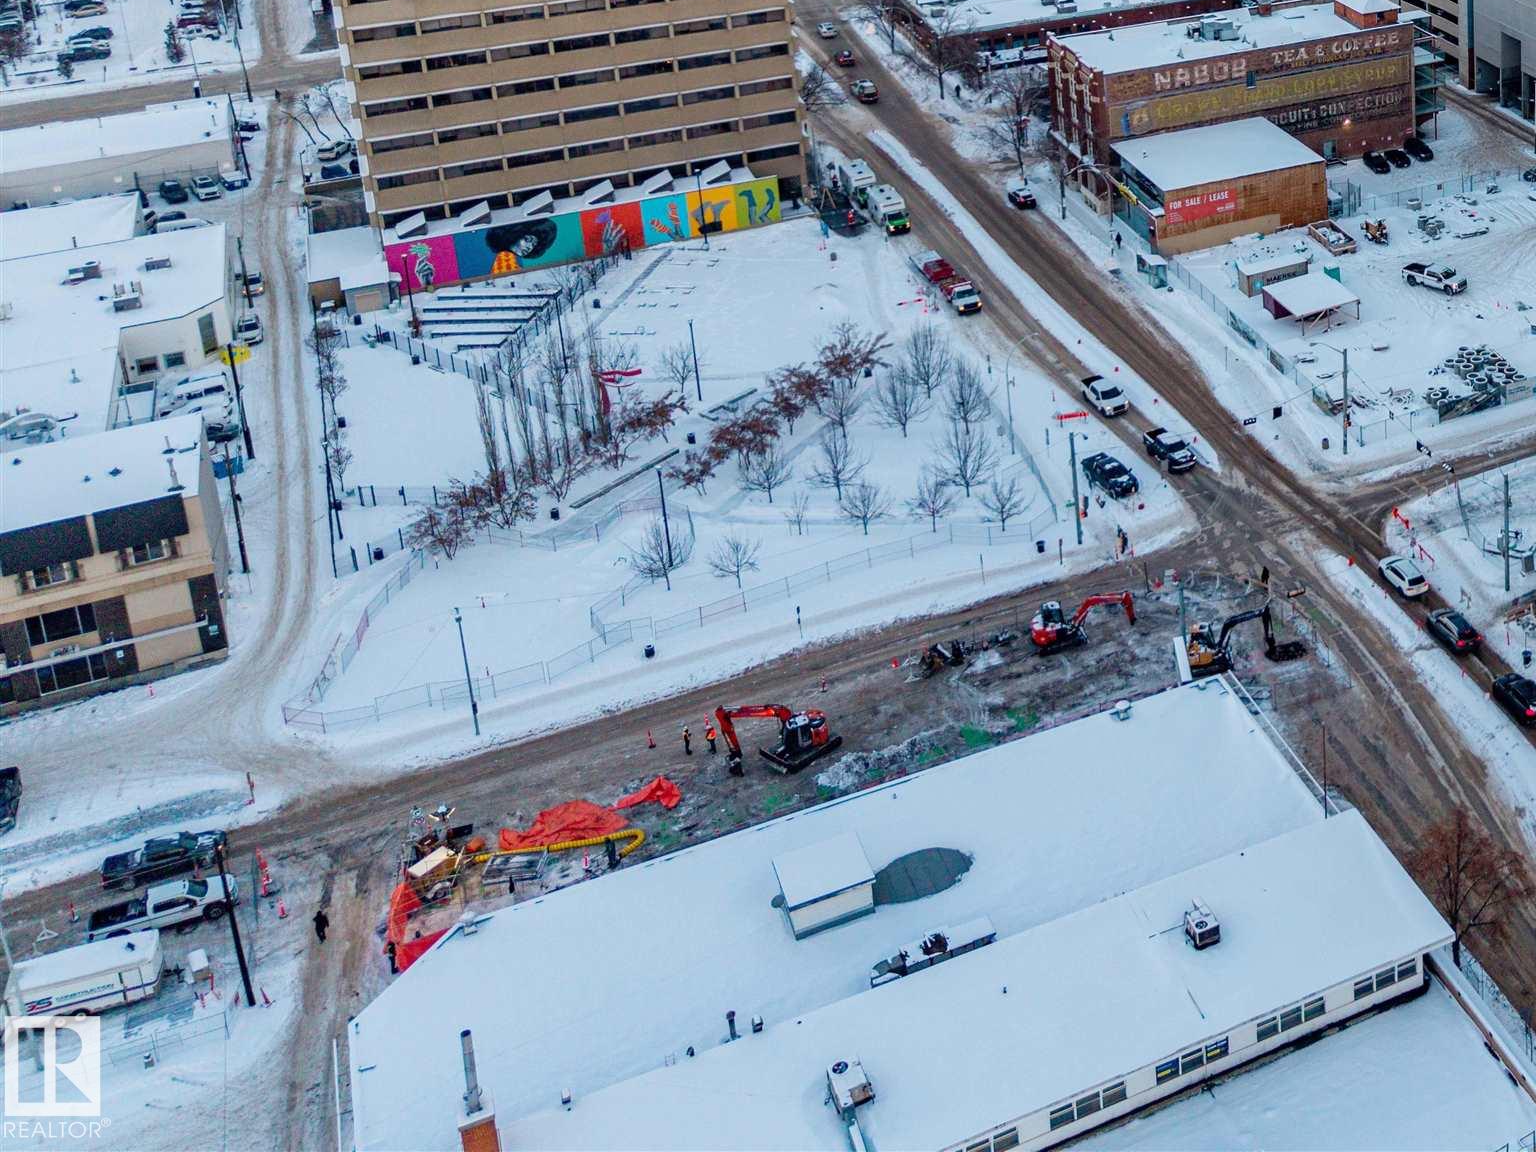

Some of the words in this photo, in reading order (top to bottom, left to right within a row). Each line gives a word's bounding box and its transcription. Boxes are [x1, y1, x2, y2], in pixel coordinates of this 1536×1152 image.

[1271, 47, 1308, 65] TEA
[1331, 31, 1400, 55] COFFEE
[1169, 201, 1182, 210] FOR
[1185, 196, 1201, 207] SALE
[1209, 191, 1229, 202] LEASE
